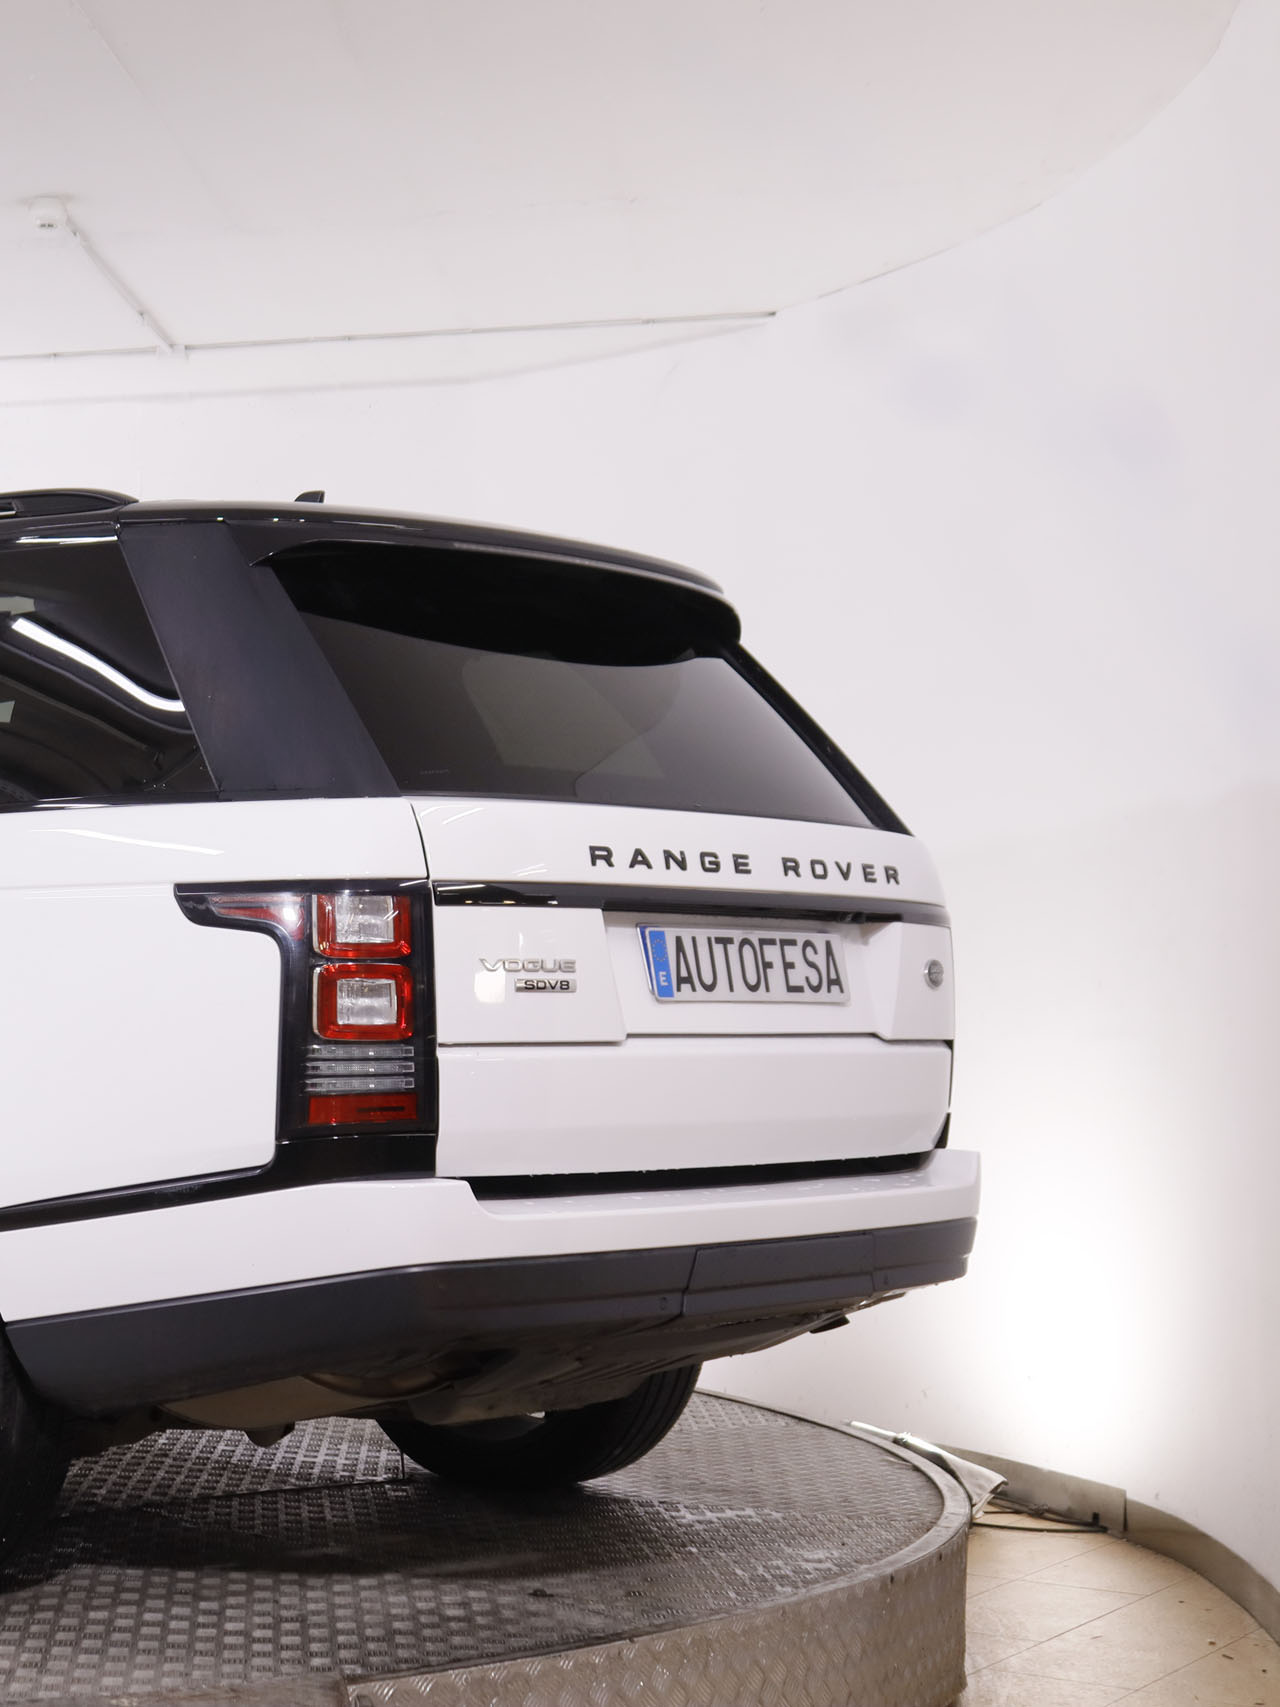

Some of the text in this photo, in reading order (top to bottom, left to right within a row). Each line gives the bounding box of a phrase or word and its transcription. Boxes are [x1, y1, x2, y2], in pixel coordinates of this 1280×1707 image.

[588, 845, 901, 886] RANGE ROVER
[478, 958, 577, 974] VOGUE
[674, 935, 845, 993] AUTOFESA
[523, 979, 571, 991] SDV8
[658, 970, 669, 986] E
